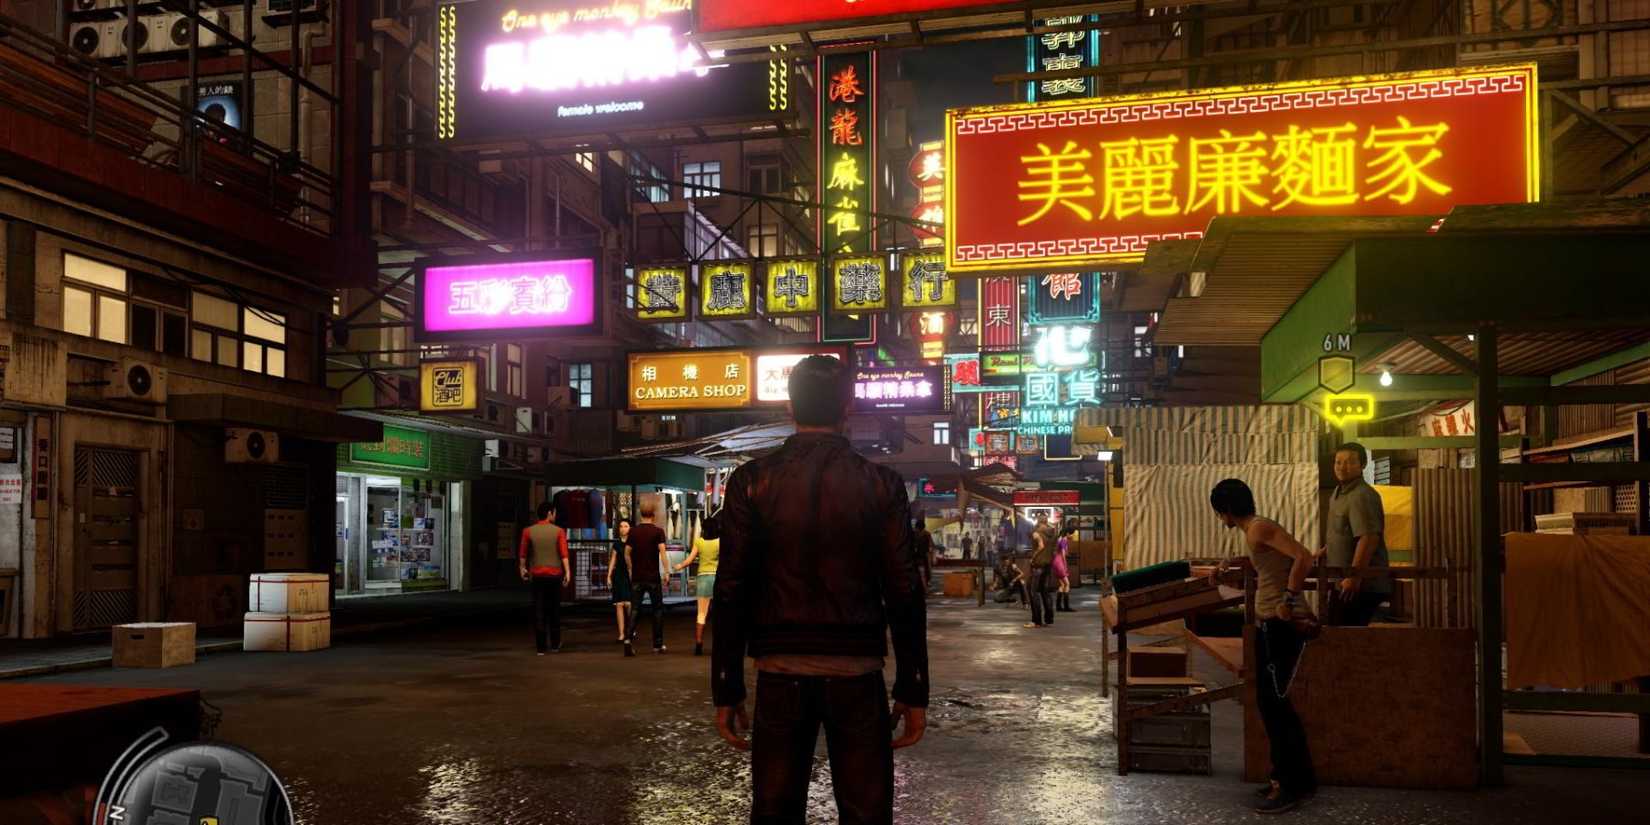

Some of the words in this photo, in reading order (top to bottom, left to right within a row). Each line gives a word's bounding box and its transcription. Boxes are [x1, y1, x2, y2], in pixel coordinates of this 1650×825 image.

[501, 9, 536, 32] One
[540, 11, 570, 33] eye
[645, 0, 691, 17] Saun
[828, 64, 865, 253] 港龍麻雀
[1016, 113, 1453, 227] 美麗廉麵家
[435, 370, 464, 388] Club
[641, 363, 740, 382] 相機店
[635, 386, 699, 400] CAMERA
[704, 384, 746, 398] SHOP
[1026, 368, 1100, 406] 國貨
[1022, 409, 1052, 423] KIM
[1018, 425, 1056, 435] CHINESE
